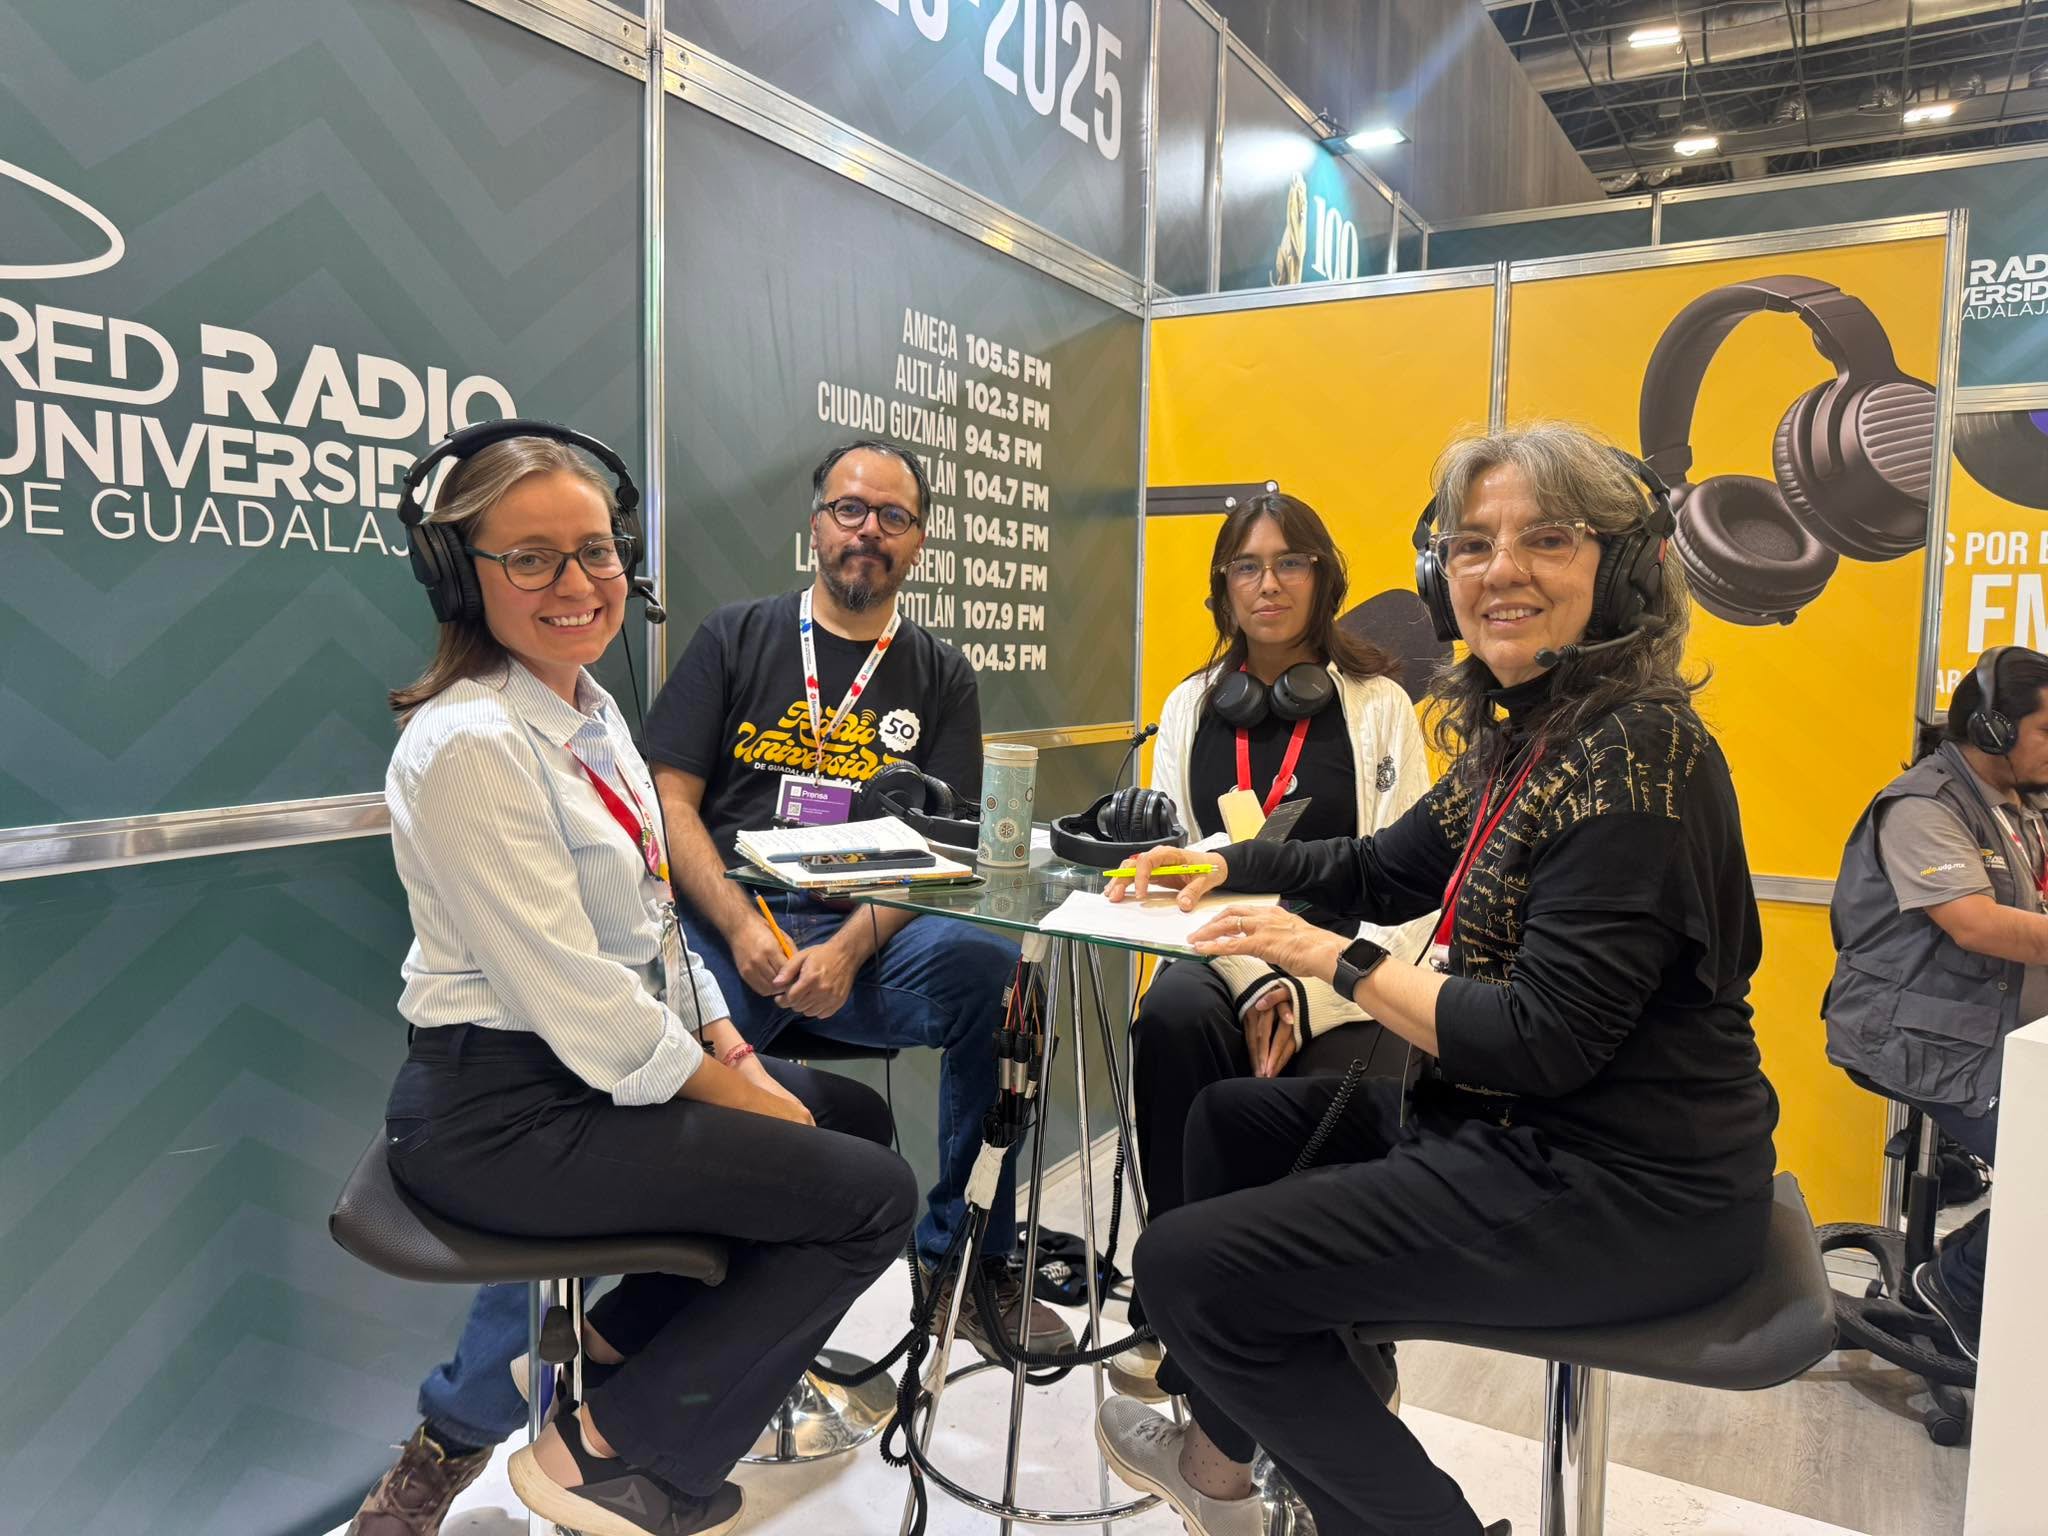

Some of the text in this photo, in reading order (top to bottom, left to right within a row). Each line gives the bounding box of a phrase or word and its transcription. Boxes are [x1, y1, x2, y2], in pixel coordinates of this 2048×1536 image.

[1313, 195, 1359, 281] 100
[1970, 254, 2048, 286] RAD
[1962, 302, 2048, 321] ADALAJ
[902, 307, 1051, 390] AMECA 105.5 FM
[0, 297, 518, 446] RED RADIO
[895, 353, 1050, 431] AUTLÁN 102.3 FM
[817, 380, 1042, 470] CIUDAD GUZMÁN 94.3 FM
[963, 469, 1019, 506] 104.7
[1022, 481, 1049, 512] FM
[963, 513, 1018, 549] 104.3
[1022, 522, 1049, 553] FM
[1964, 531, 2028, 566] POR
[963, 557, 1017, 589] 104.7
[1020, 563, 1048, 592] FM
[962, 600, 1014, 630] 107.9
[1017, 603, 1044, 632] FM
[961, 643, 1047, 672] 104.3 FM
[884, 717, 915, 740] 50
[734, 721, 906, 781] Universid
[802, 790, 829, 800] Prensa
